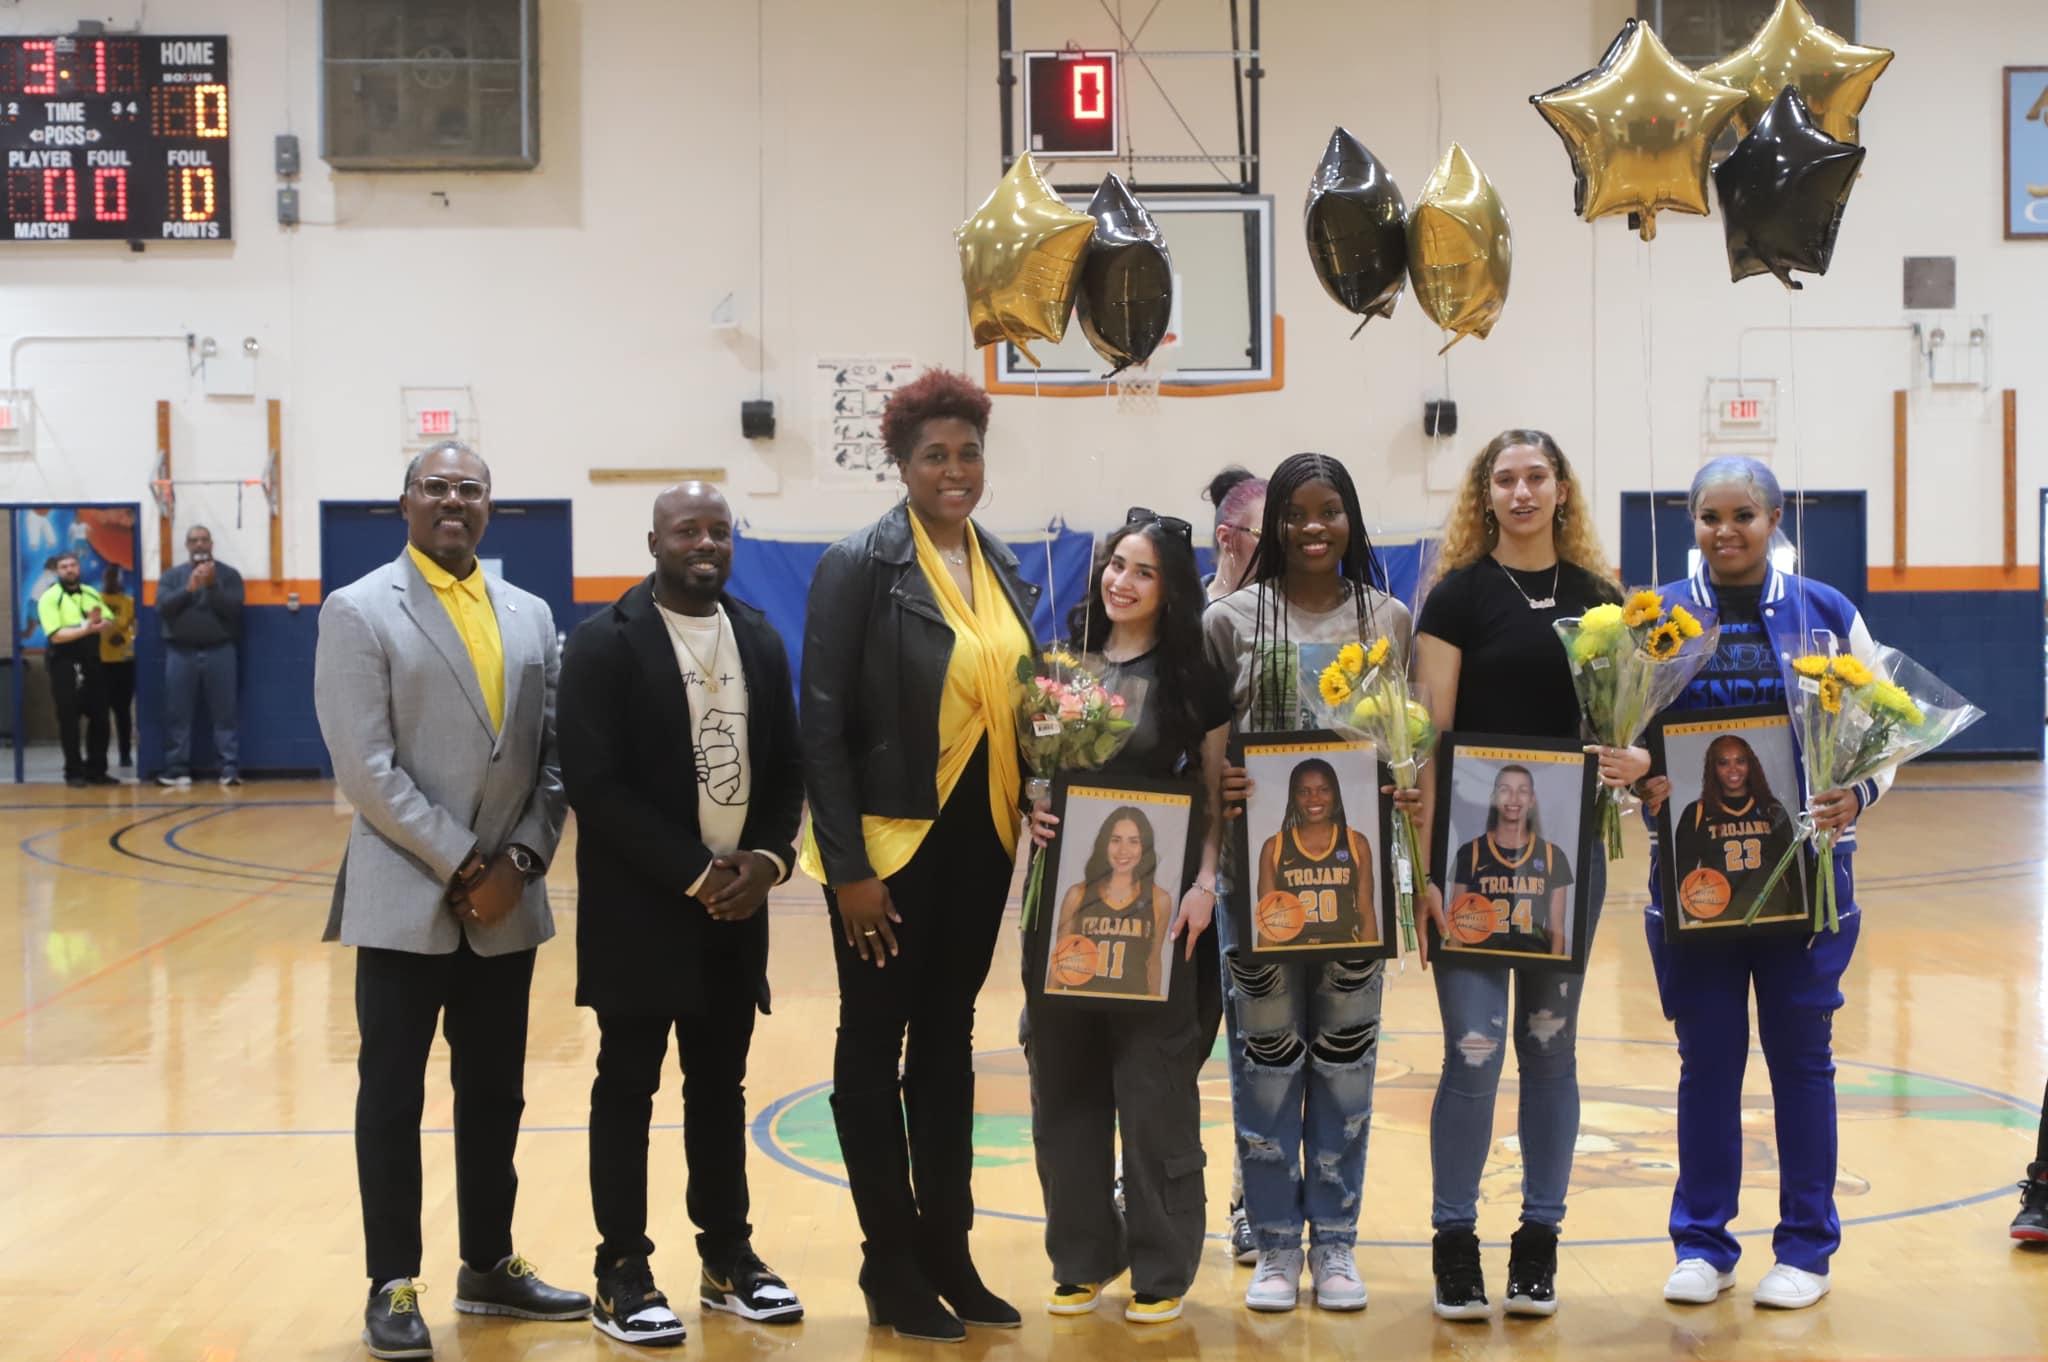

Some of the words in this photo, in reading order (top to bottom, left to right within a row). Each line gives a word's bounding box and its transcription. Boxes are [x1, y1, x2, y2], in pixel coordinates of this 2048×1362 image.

[160, 41, 215, 65] HOME
[1073, 65, 1105, 120] 0
[44, 102, 86, 122] TIME
[194, 84, 228, 138] 0
[44, 125, 85, 146] POSS
[8, 151, 73, 167] PLAYER
[87, 151, 132, 166] FOUL
[167, 150, 212, 166] FOUL
[14, 222, 70, 238] MATCH
[162, 222, 220, 238] POINTS
[1730, 399, 1758, 417] EXIT
[422, 410, 452, 432] EXIT
[1708, 820, 1773, 840] TROJANS
[1723, 838, 1762, 872] 23
[1284, 867, 1351, 888] TROJANS
[1479, 876, 1545, 895] TROJANS
[1298, 889, 1339, 924] 20
[1491, 898, 1534, 934] 24
[1094, 940, 1127, 979] 11
